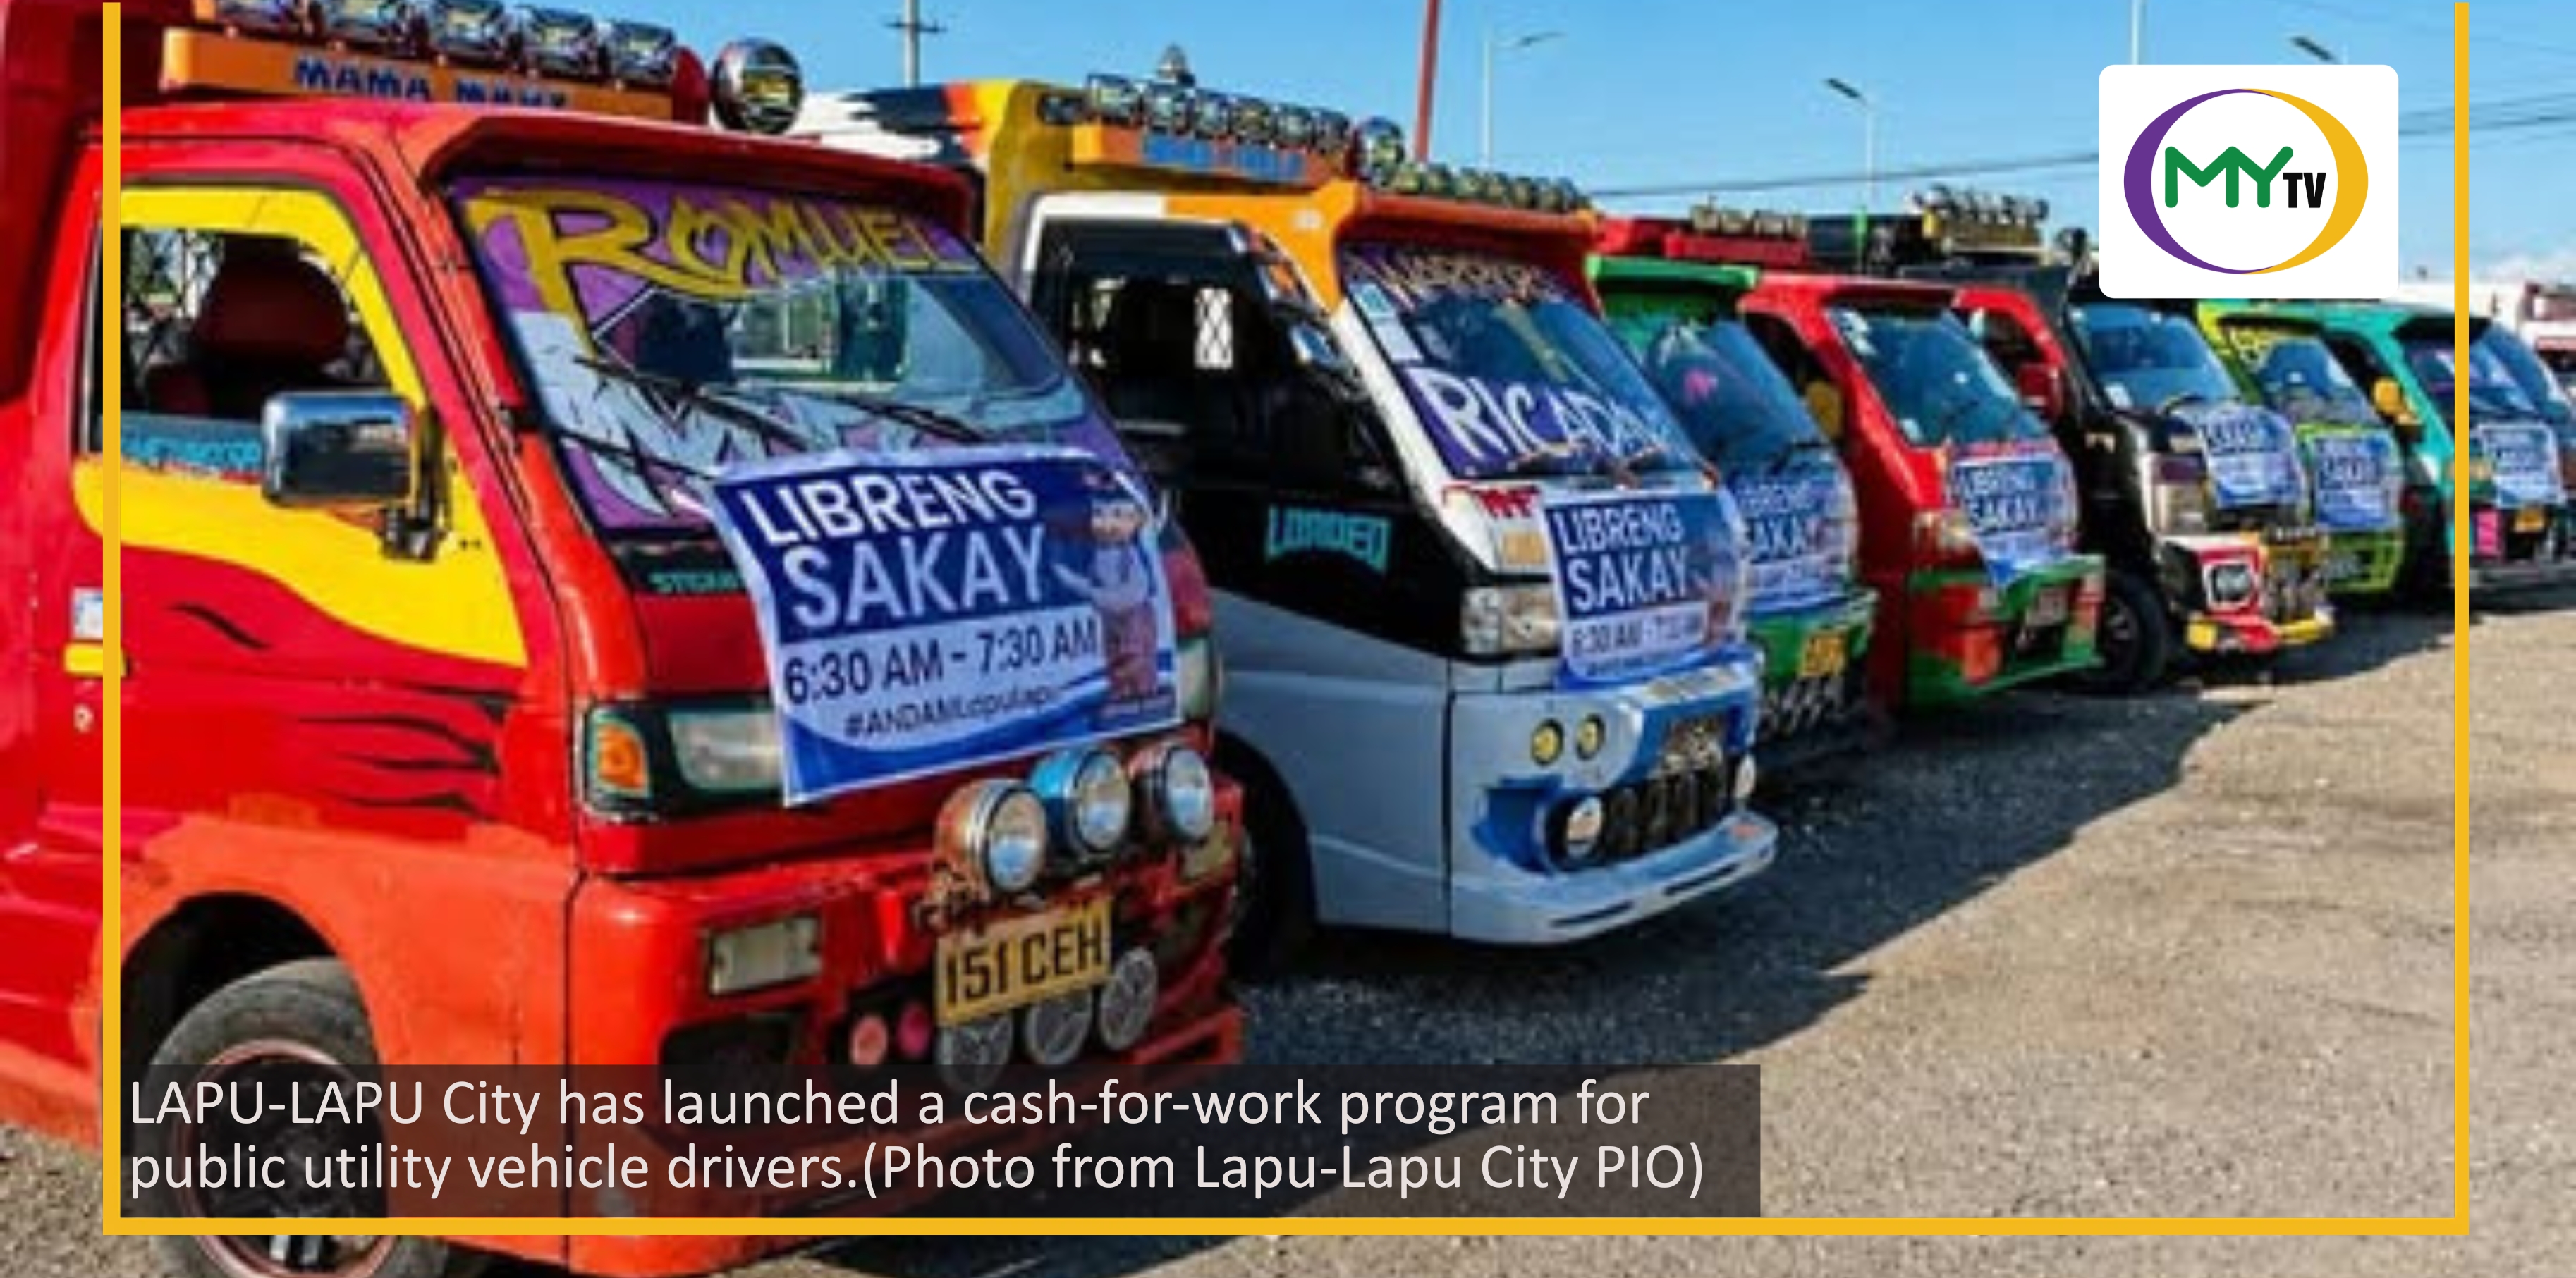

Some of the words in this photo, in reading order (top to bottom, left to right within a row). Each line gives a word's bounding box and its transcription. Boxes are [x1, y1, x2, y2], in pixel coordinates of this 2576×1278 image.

[295, 56, 432, 102] MAMA
[462, 186, 982, 358] ROMUEL
[740, 468, 1038, 546] LIBRENG
[1266, 503, 1391, 575] LOADED
[1553, 502, 1685, 553] LIBRENG
[781, 524, 1046, 629] SAKAY
[1565, 547, 1691, 613] SAKAY
[784, 647, 874, 704] 6:30
[881, 636, 945, 687] AM
[977, 627, 1046, 675] 7:30
[1052, 616, 1099, 661] AM
[945, 932, 1010, 1006] 151
[1020, 916, 1105, 985] CEH
